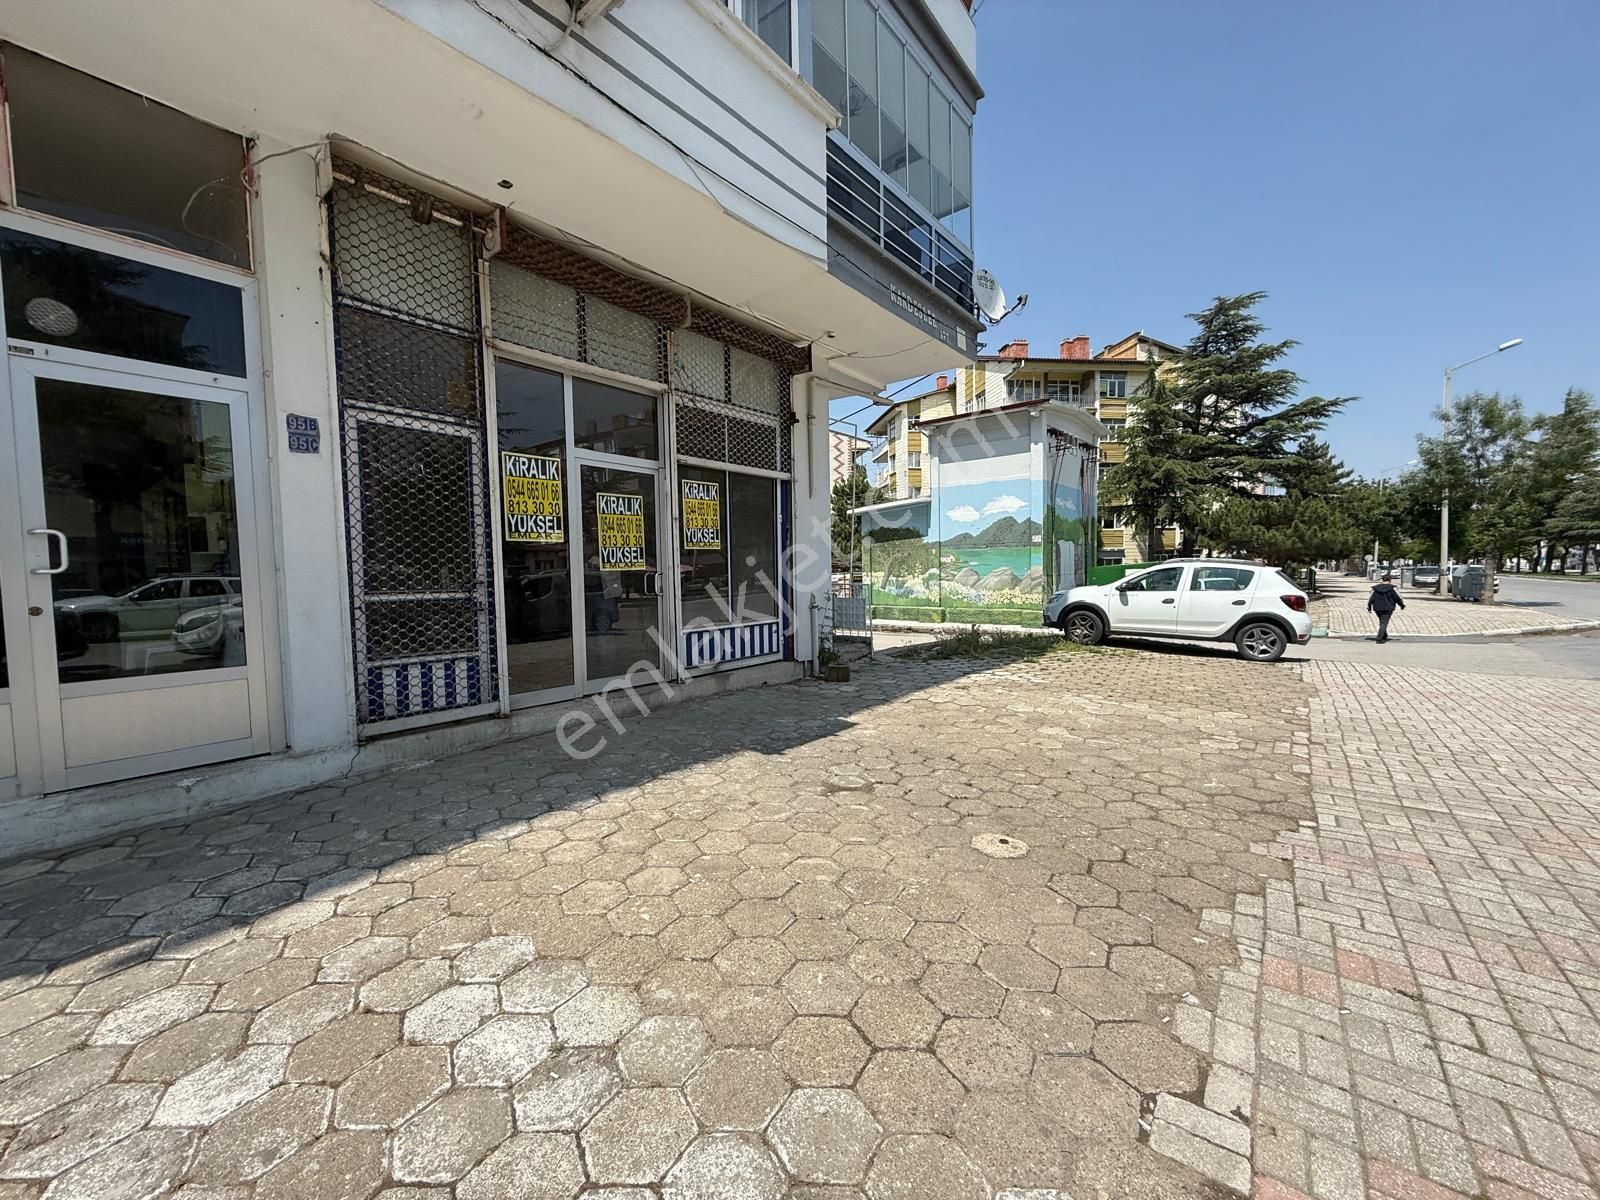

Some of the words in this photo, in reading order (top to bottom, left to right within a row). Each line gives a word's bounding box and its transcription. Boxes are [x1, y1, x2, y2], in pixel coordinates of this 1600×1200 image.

[289, 416, 306, 430] 95
[290, 436, 307, 450] 95
[508, 478, 525, 498] 0544
[526, 481, 539, 501] 665
[541, 482, 549, 501] 01
[551, 483, 560, 502] 66
[508, 500, 528, 513] 813
[532, 502, 545, 514] 30
[548, 503, 560, 515] 30
[686, 517, 699, 528] 813
[700, 518, 709, 528] 30
[711, 519, 718, 528] 30
[601, 534, 617, 546] 813
[620, 535, 630, 546] 30
[632, 535, 642, 546] 30
